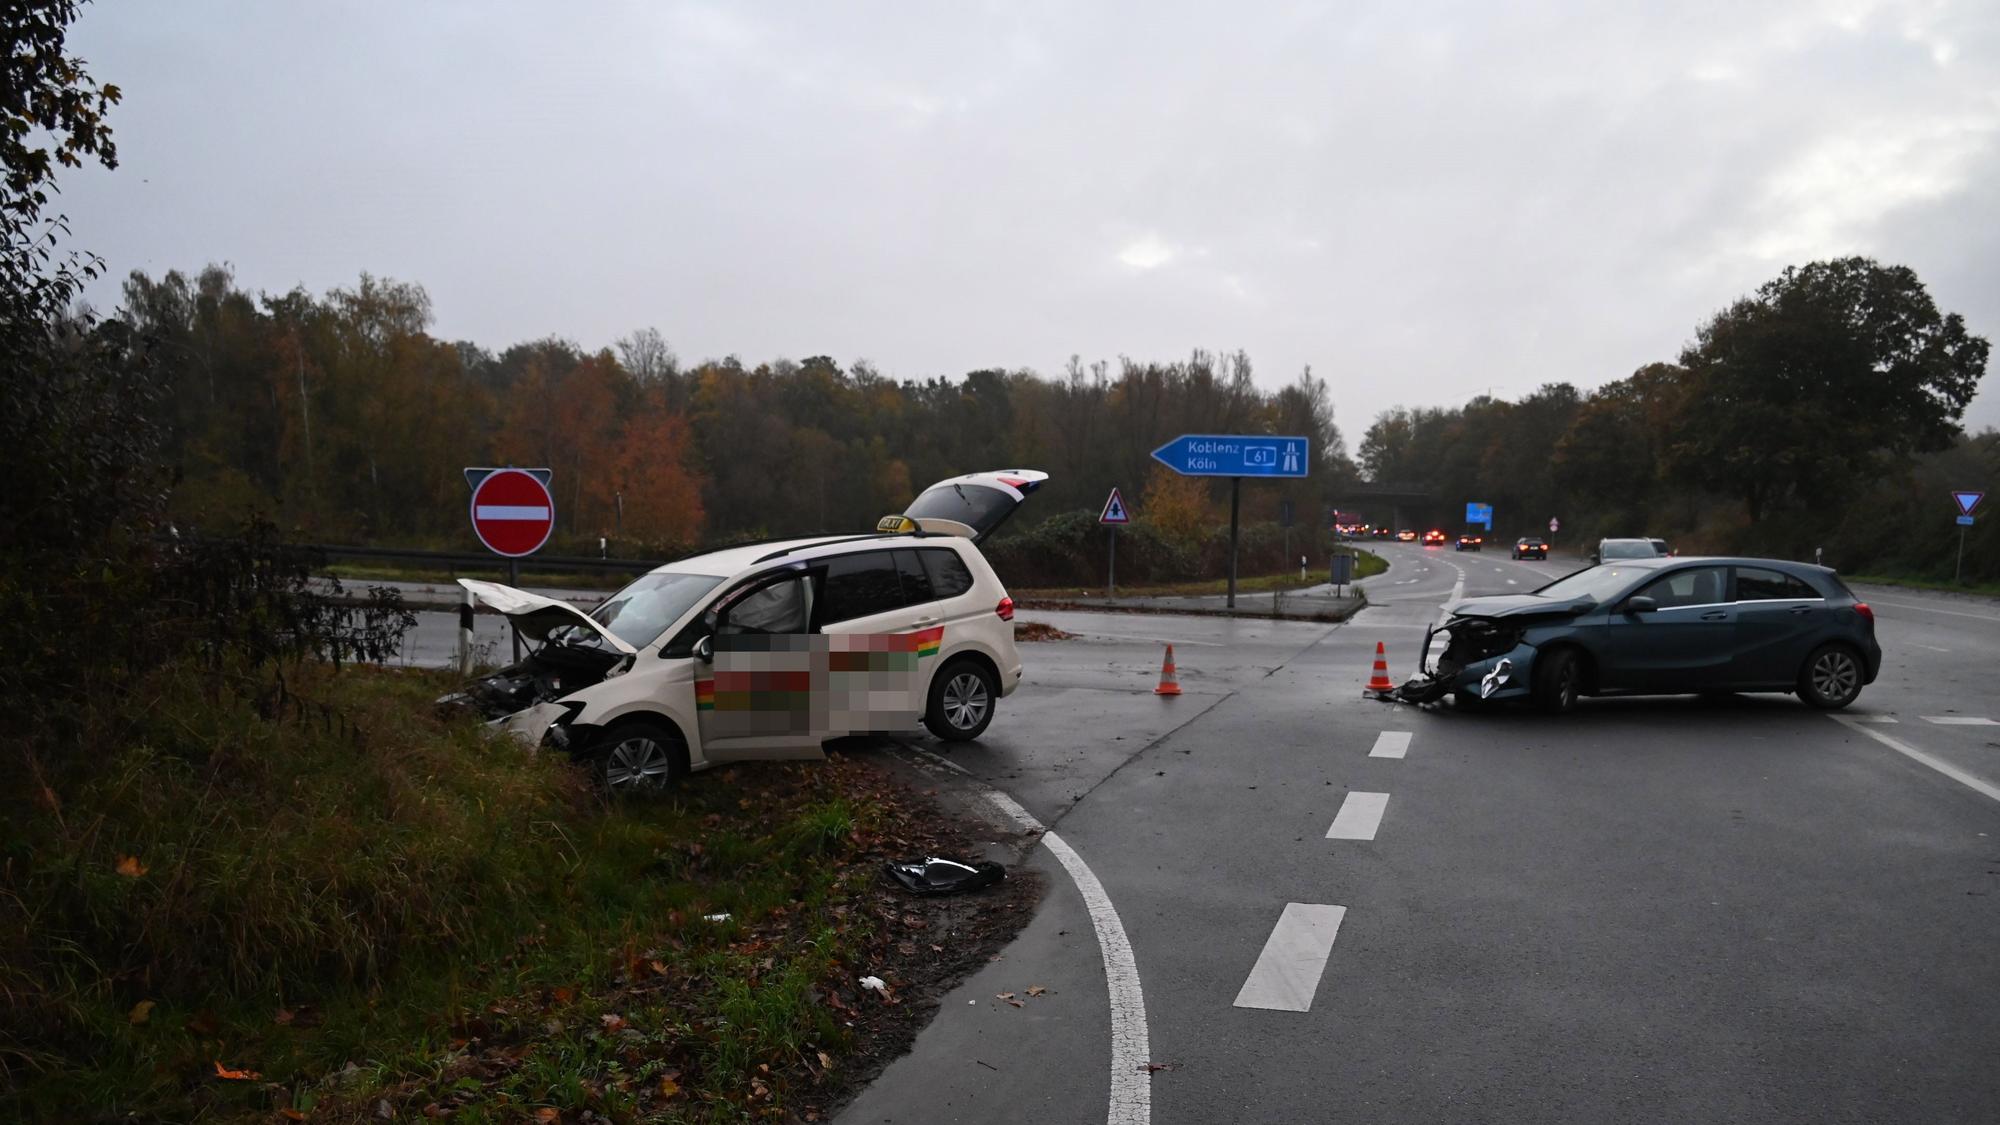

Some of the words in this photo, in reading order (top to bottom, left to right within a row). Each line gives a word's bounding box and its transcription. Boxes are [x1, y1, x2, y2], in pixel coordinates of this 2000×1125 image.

[1188, 441, 1240, 454] Koblenz
[1254, 450, 1267, 463] 61
[1188, 457, 1217, 470] Köln
[880, 518, 902, 529] TAXI
